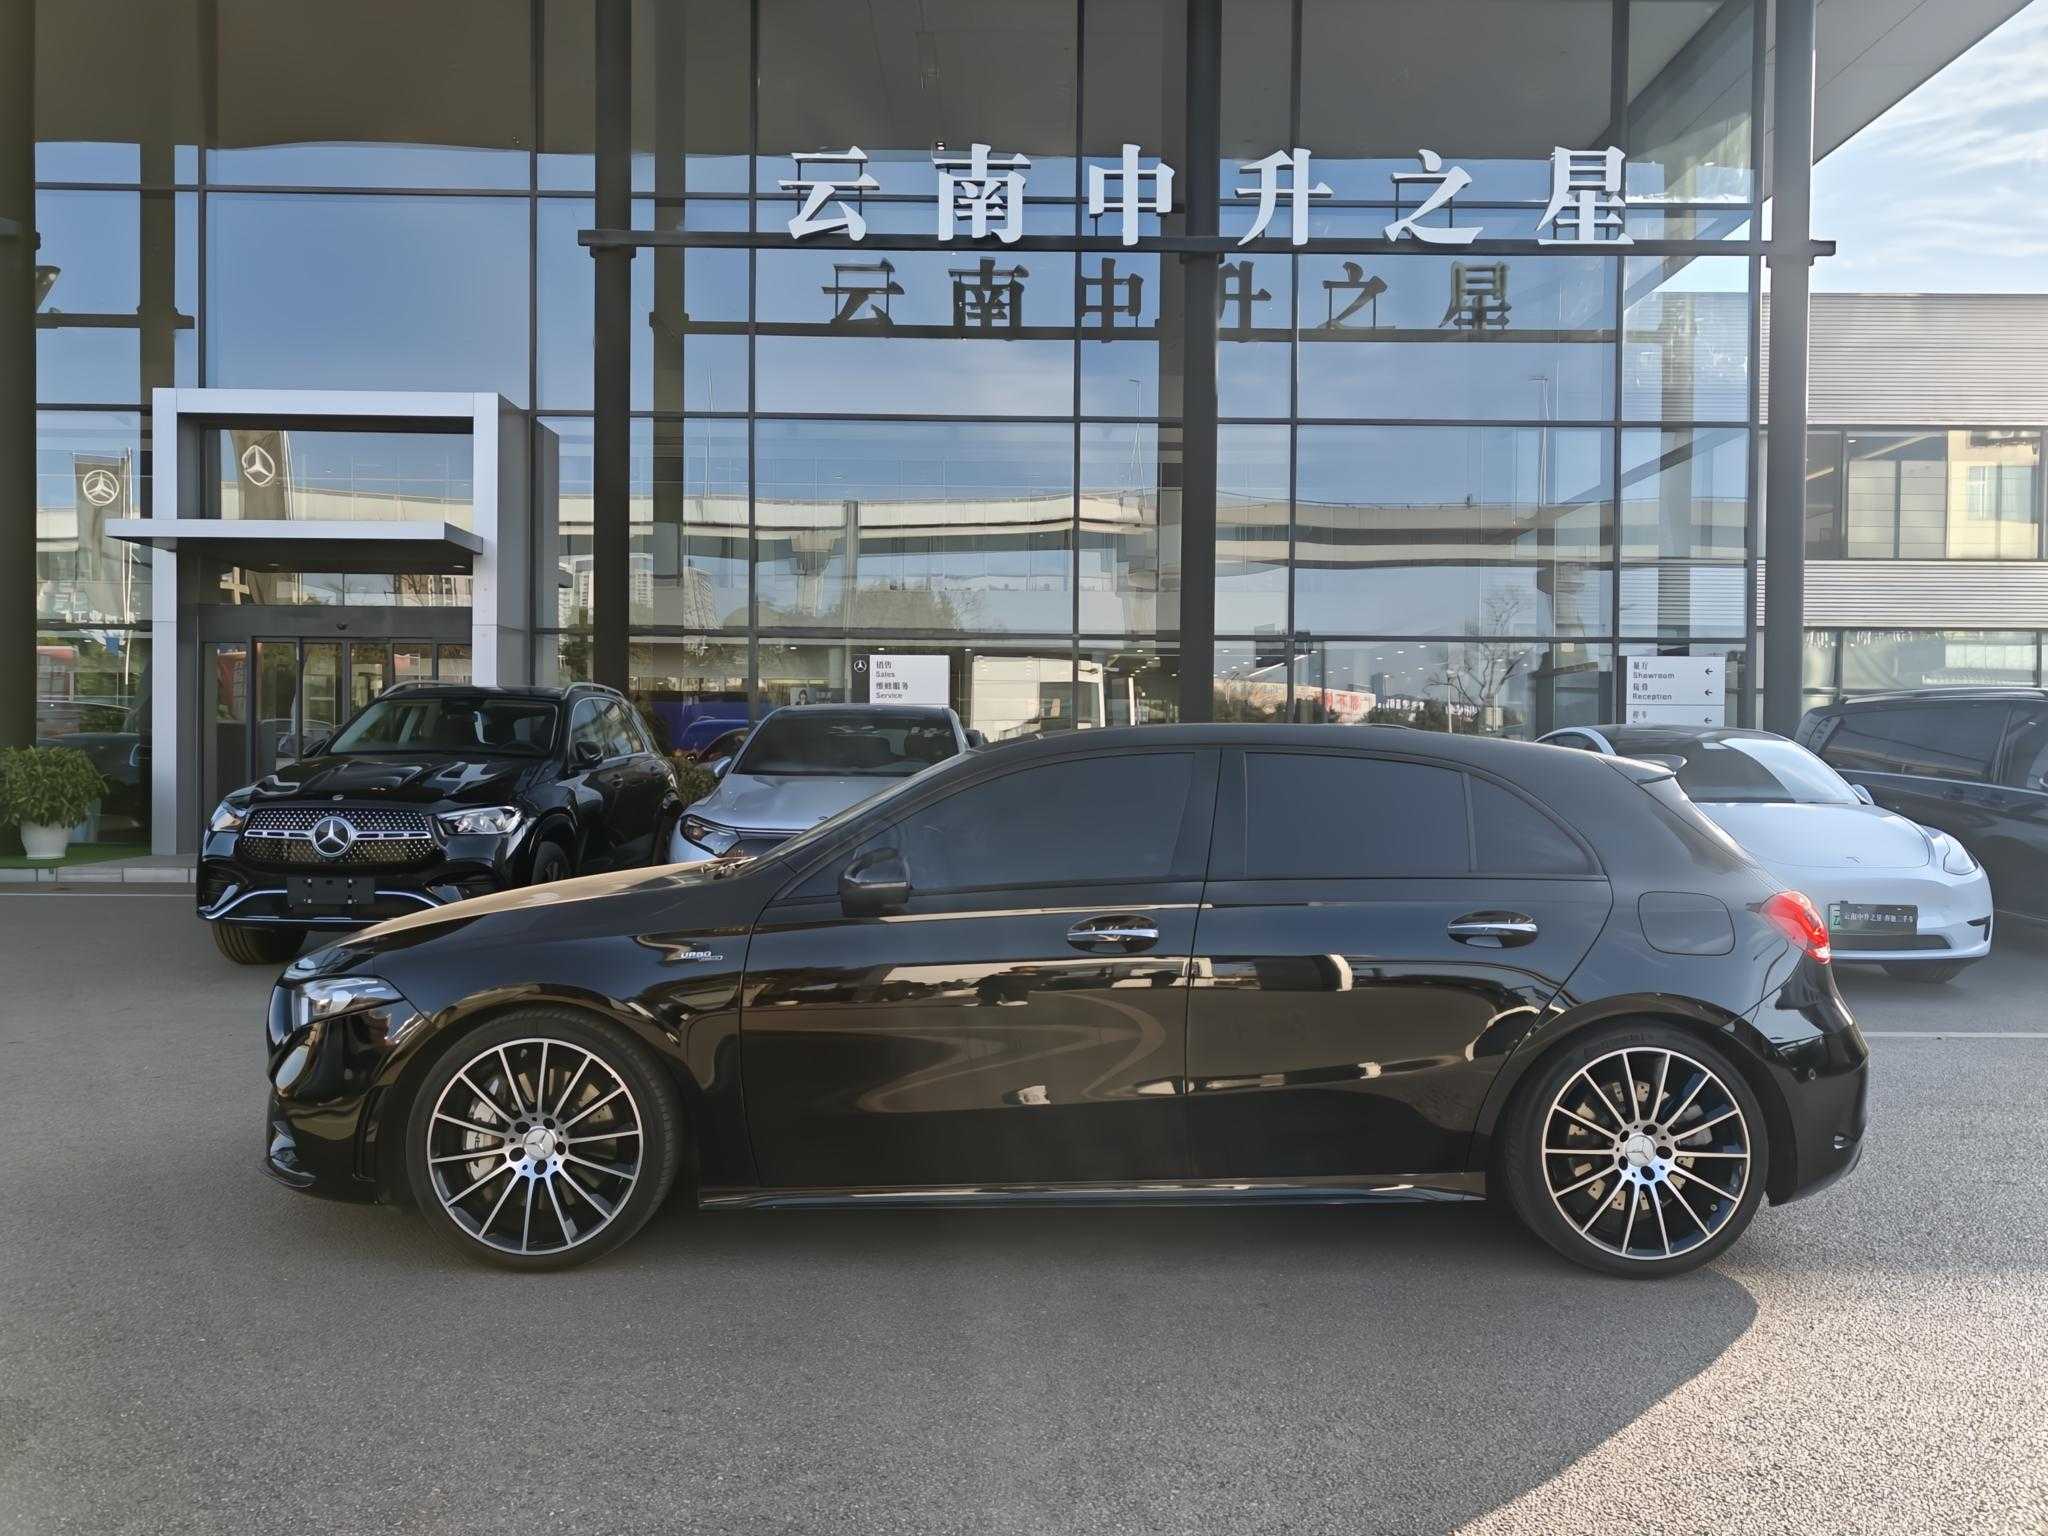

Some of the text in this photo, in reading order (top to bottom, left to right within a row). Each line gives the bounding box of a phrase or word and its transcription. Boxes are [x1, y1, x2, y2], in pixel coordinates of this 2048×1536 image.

[778, 143, 1634, 246] 云南中升之星
[1632, 671, 1675, 679] Showroom
[1632, 693, 1672, 701] Reception
